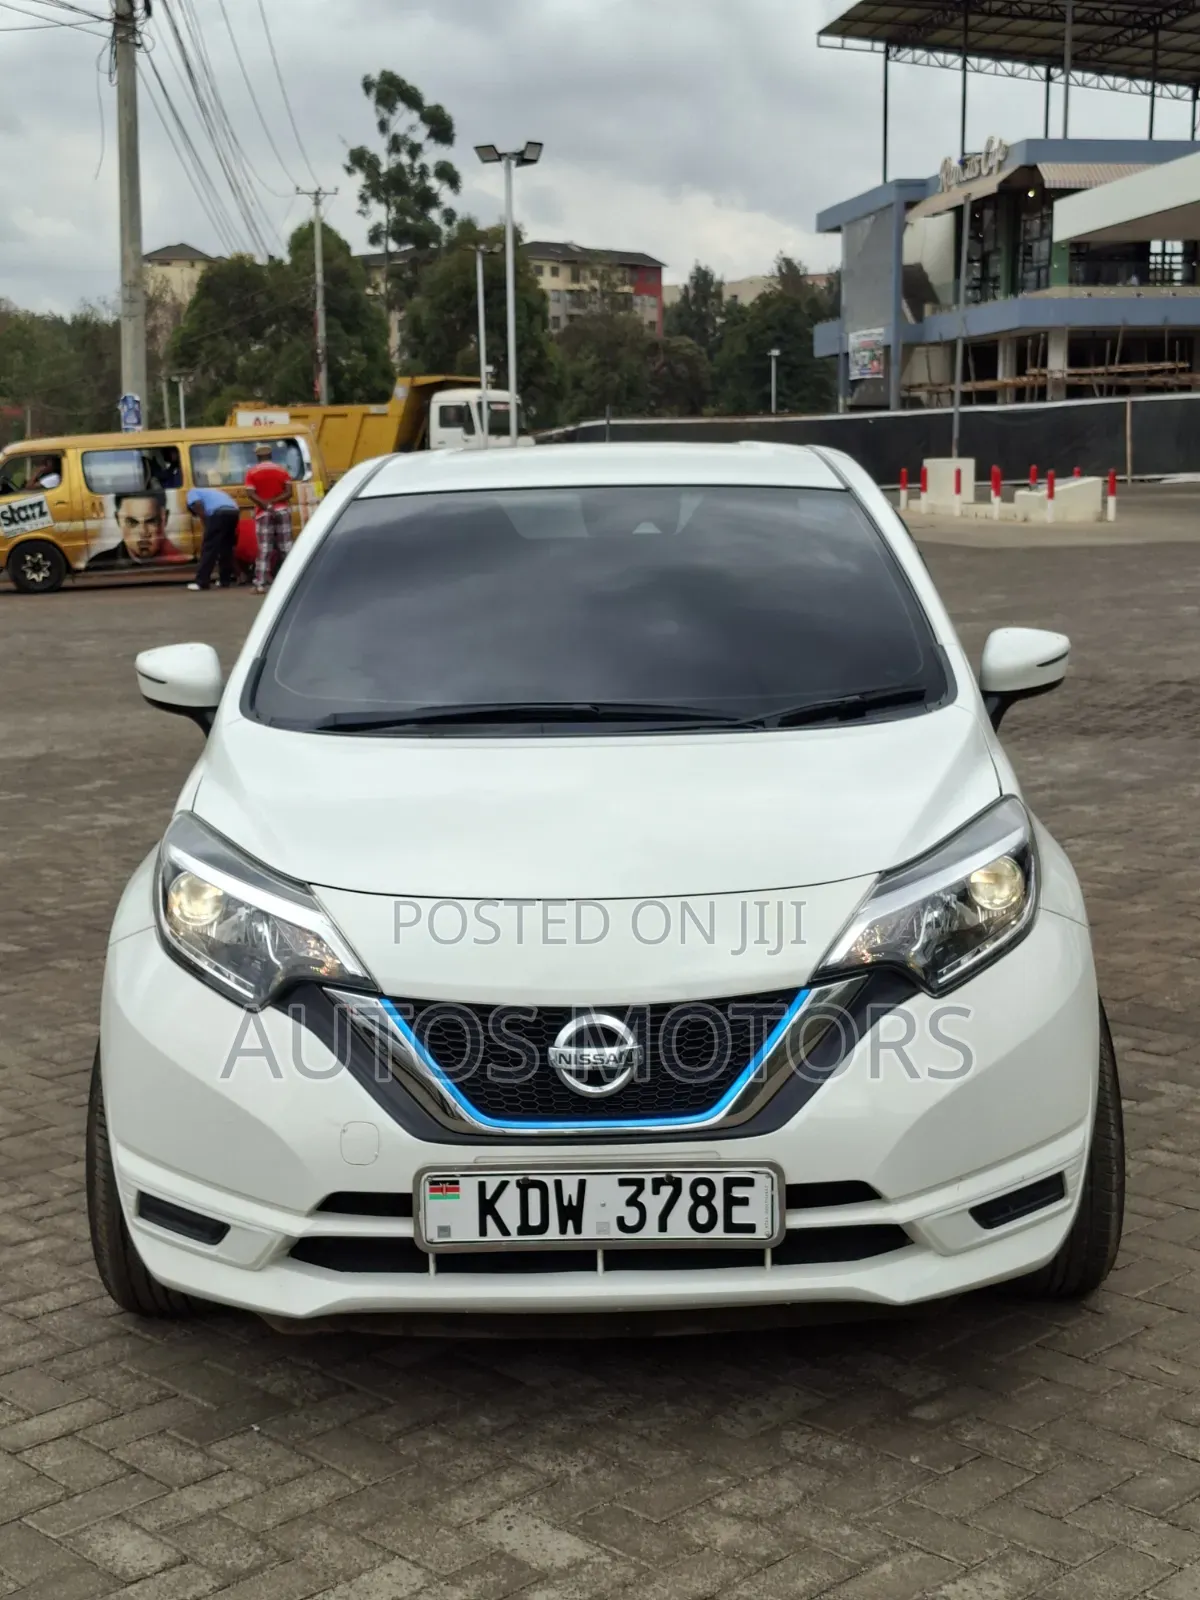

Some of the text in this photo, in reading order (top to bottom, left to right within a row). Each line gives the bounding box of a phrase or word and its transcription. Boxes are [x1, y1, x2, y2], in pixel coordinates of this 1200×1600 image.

[558, 1049, 635, 1066] NISSAN
[477, 1178, 587, 1237] KDW
[616, 1176, 757, 1235] 378E
